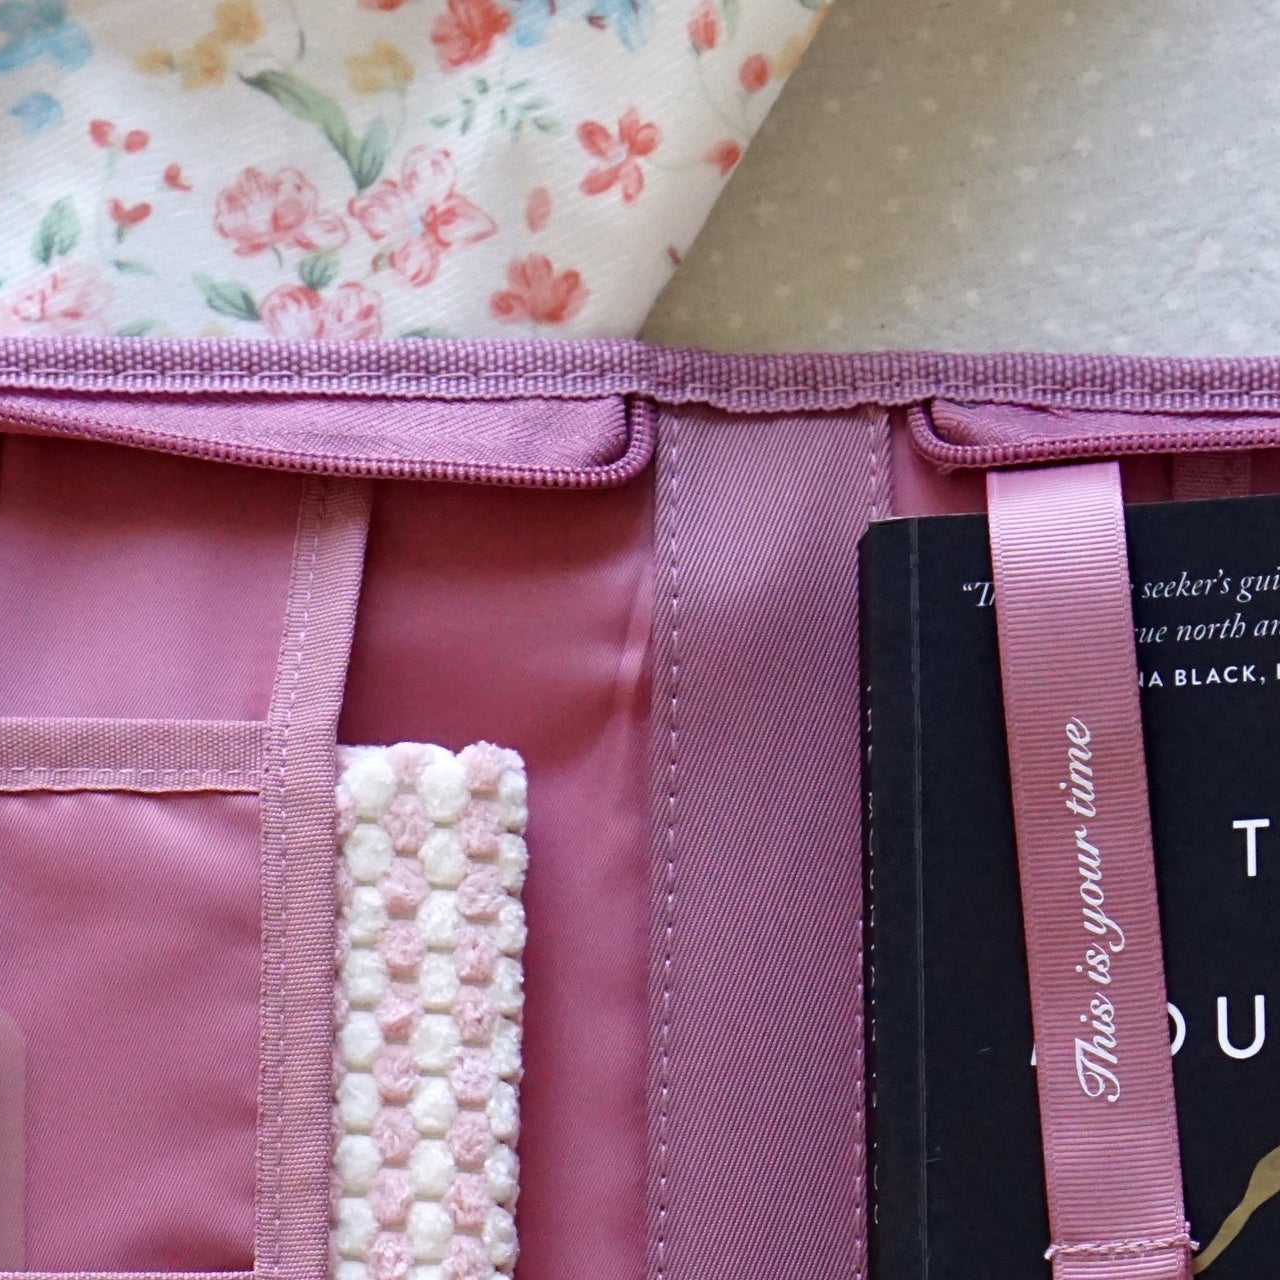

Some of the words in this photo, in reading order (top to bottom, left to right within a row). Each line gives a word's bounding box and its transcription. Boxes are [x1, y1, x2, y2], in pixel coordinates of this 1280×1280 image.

[1141, 568, 1232, 599] seeker’s
[1134, 626, 1168, 644] ue
[1176, 612, 1246, 642] north
[1174, 664, 1266, 687] BLACK,
[1059, 716, 1097, 818] time
[1074, 824, 1125, 953] your
[1075, 942, 1112, 985] is
[1073, 991, 1121, 1103] This
